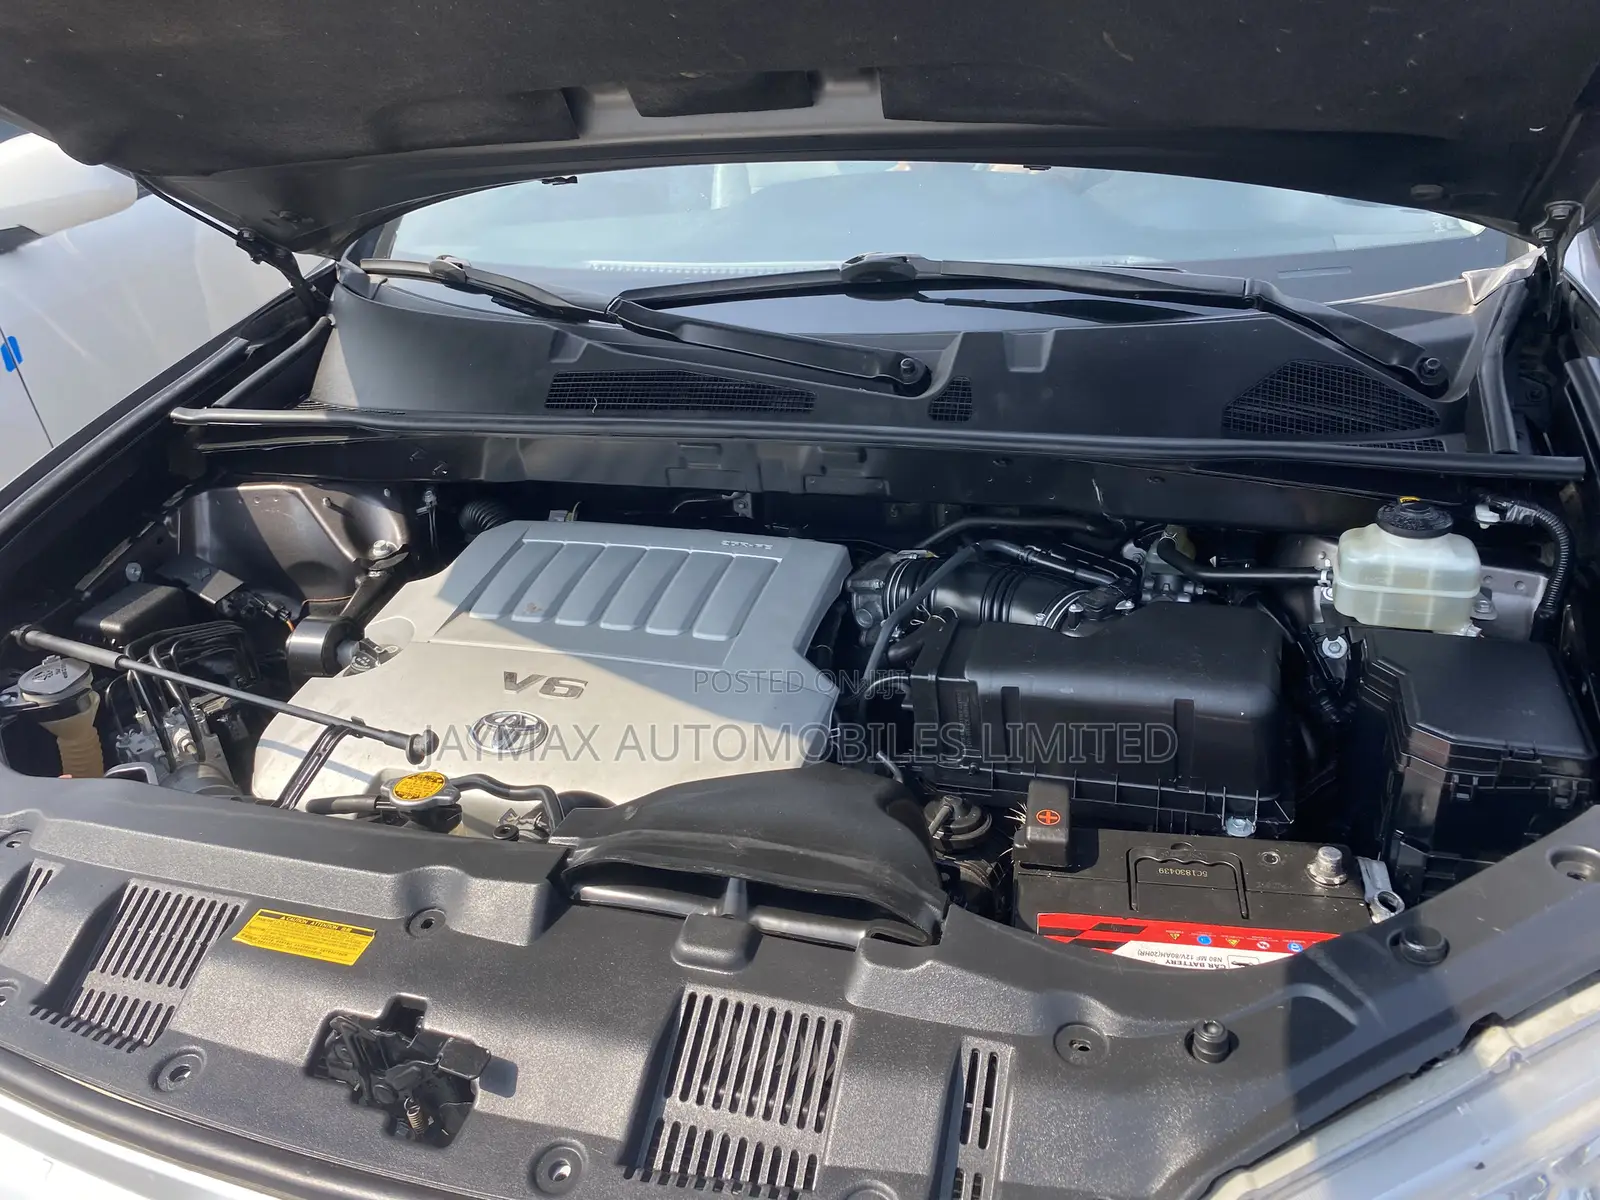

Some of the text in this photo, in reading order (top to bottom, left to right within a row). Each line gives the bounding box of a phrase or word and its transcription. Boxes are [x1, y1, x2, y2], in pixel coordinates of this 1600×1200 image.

[503, 671, 588, 699] V6
[286, 916, 308, 925] CAUTION
[310, 921, 339, 930] ATTENTION
[1165, 959, 1205, 968] BATTERY
